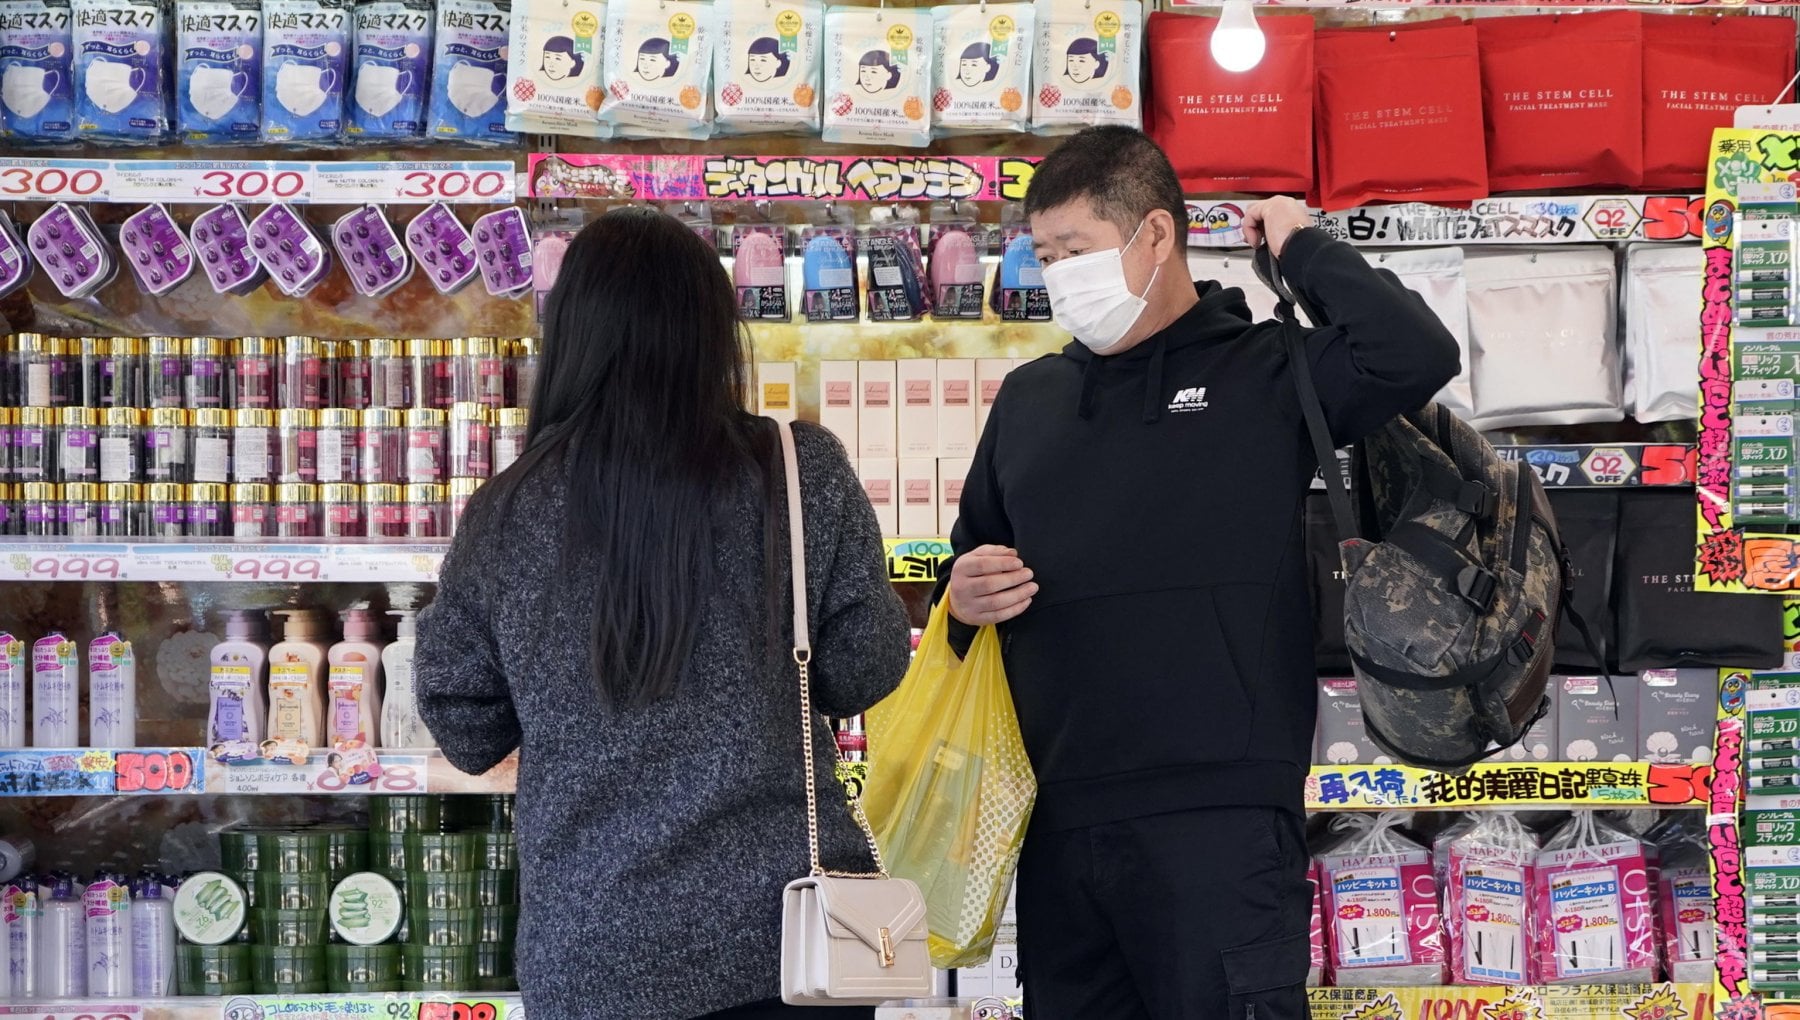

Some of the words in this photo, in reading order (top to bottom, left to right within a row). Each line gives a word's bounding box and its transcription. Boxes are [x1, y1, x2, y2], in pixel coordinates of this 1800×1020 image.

[77, 9, 155, 27] 快適マスク
[181, 14, 259, 33] 快適マスク
[268, 13, 343, 30] 快適マスク
[357, 14, 427, 31] 快適マスク
[443, 11, 511, 28] 快適マス
[1178, 95, 1203, 105] THE
[1210, 95, 1243, 104] STEM
[1250, 94, 1284, 103] CELL
[1504, 91, 1530, 101] THE
[1537, 90, 1573, 99] STEM
[1579, 88, 1614, 98] CELL
[1661, 90, 1687, 100] THE
[1694, 91, 1728, 102] STEM
[1735, 93, 1769, 103] CELL
[1183, 107, 1209, 115] FACIAL
[1211, 106, 1255, 114] TREATMENT
[1258, 105, 1279, 113] MASK
[1344, 110, 1371, 122] THE
[1377, 107, 1412, 120] STEM
[1419, 104, 1454, 115] CELL
[1509, 103, 1537, 112] FACIAL
[1539, 102, 1585, 110] TREATMENT
[1695, 103, 1738, 111] TREATMEN
[1, 169, 103, 195] 300
[203, 171, 305, 197] 300
[404, 171, 505, 197] 300
[1477, 203, 1518, 216] CELL
[1595, 210, 1626, 228] 92
[1599, 227, 1626, 236] OFF
[1766, 252, 1788, 265] XD
[1742, 366, 1780, 375] スティック
[1168, 402, 1184, 410] keep
[1185, 401, 1208, 409] moving
[1765, 448, 1787, 460] XD
[1591, 456, 1622, 475] 92
[1594, 475, 1621, 483] OFF
[33, 558, 120, 578] 999
[233, 559, 321, 579] 999
[1776, 720, 1798, 733] XD
[115, 752, 194, 791] 500
[1319, 768, 1406, 804] 再入荷
[1420, 767, 1588, 804] 我的美麗日記
[1757, 833, 1795, 843] スティック
[1601, 846, 1622, 857] KIT
[1338, 881, 1389, 891] ハッピーキット
[1390, 880, 1397, 888] B
[1467, 879, 1514, 892] ハッピーキット
[1515, 885, 1521, 893] B
[1555, 885, 1605, 898] ハッピーキット
[1608, 883, 1614, 891] B
[386, 1002, 411, 1020] 92
